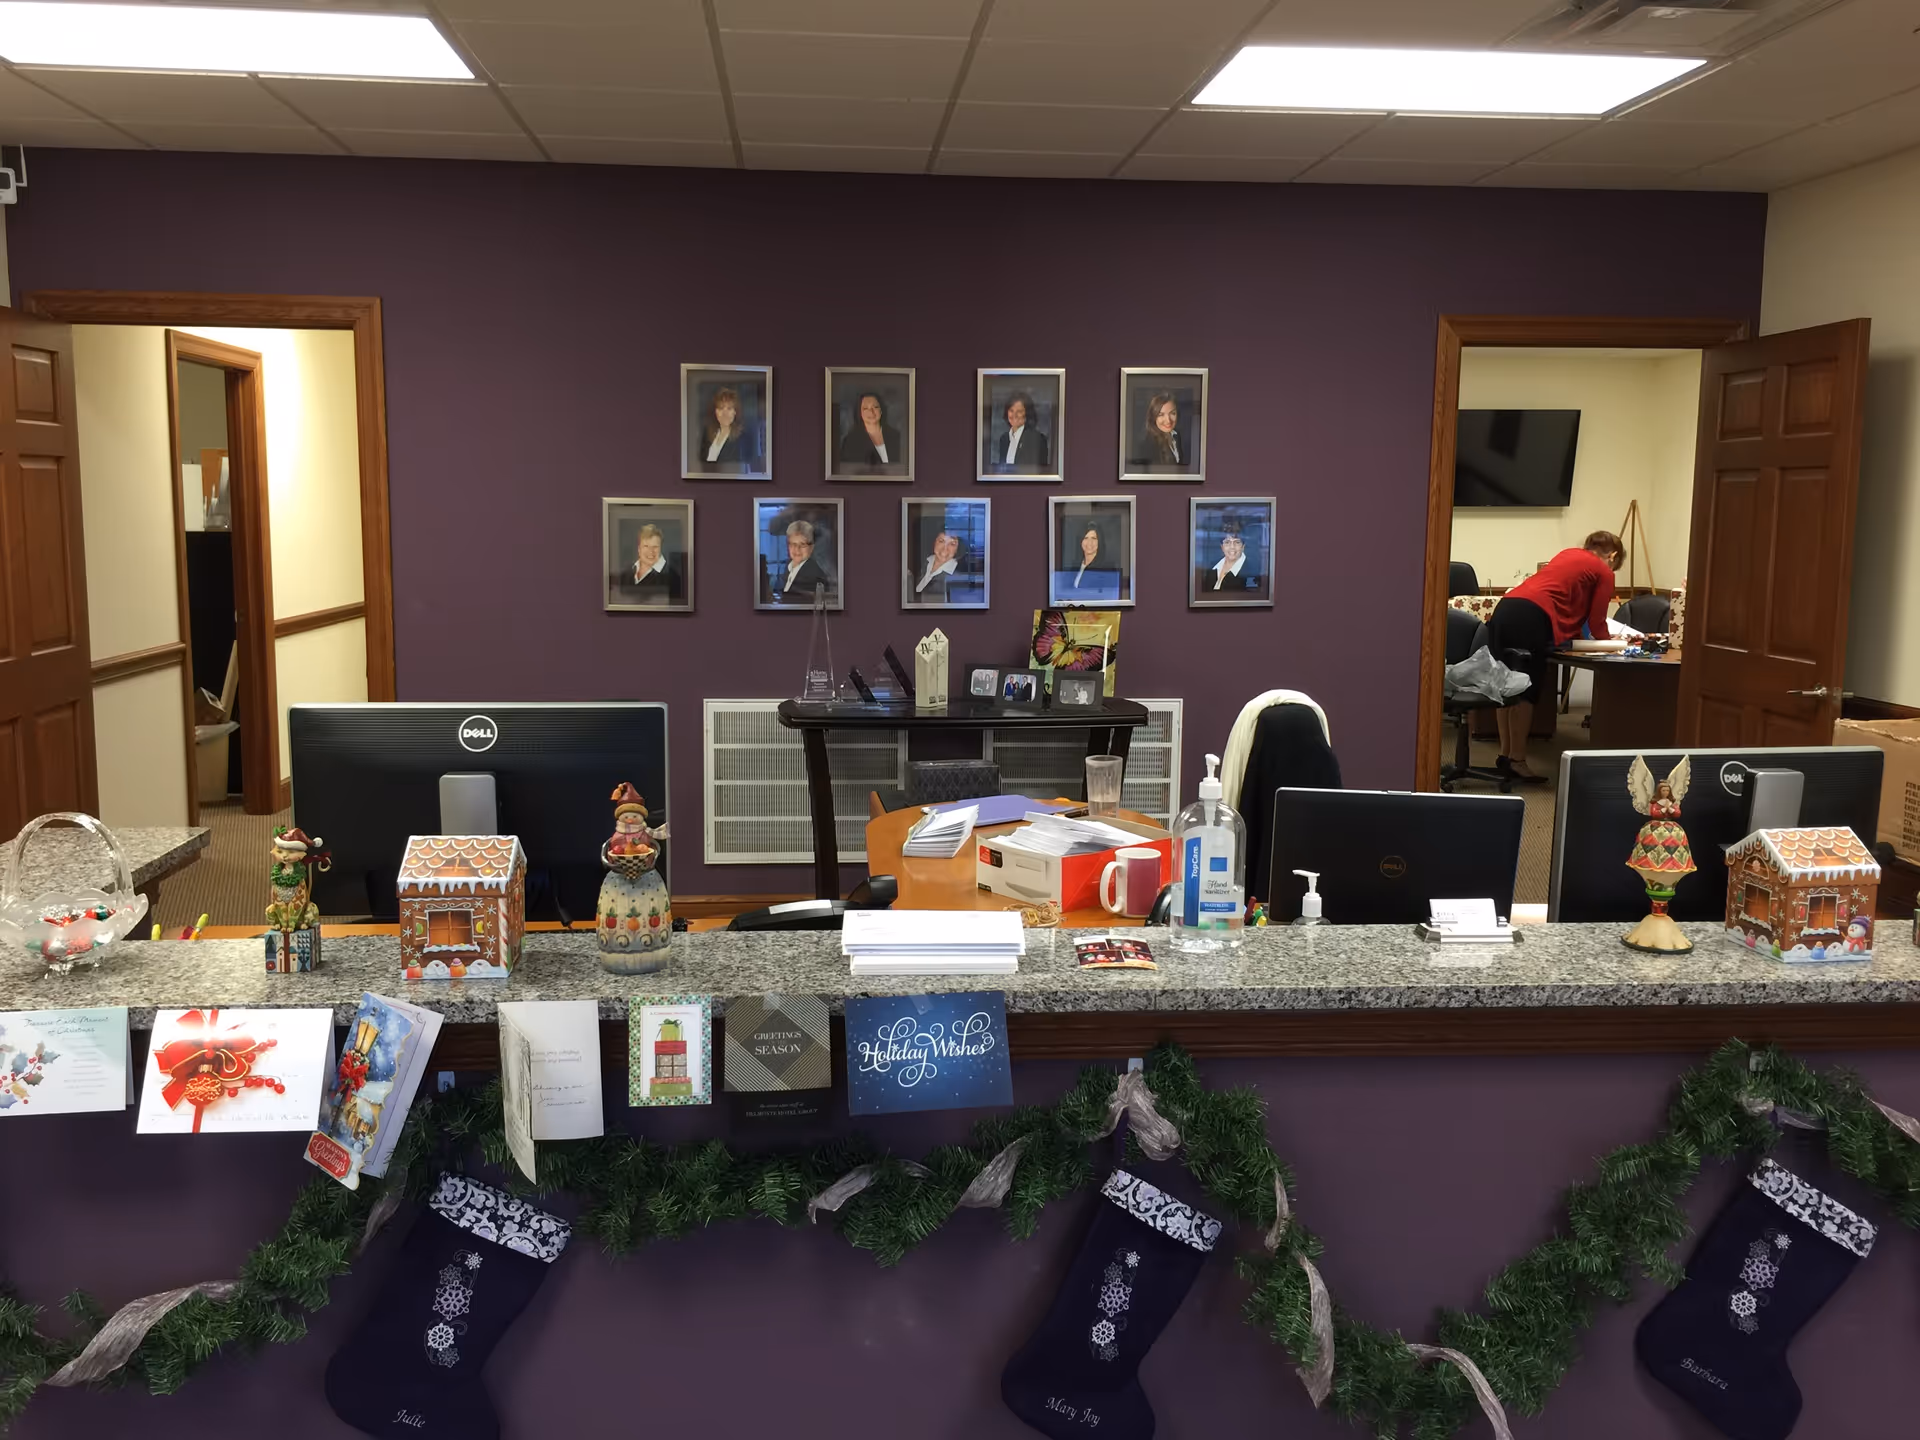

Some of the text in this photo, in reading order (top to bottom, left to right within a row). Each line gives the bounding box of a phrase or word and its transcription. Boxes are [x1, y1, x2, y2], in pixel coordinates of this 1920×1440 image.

[463, 728, 494, 738] DELL
[1723, 773, 1745, 783] DEL
[1191, 845, 1199, 878] TopCare
[1207, 880, 1228, 889] Hand
[754, 1031, 802, 1040] GREETINGS
[754, 1044, 801, 1055] SEASON
[858, 1012, 995, 1087] Holiday Wishes
[311, 1140, 347, 1174] Greetings
[1680, 1357, 1729, 1390] Barbara
[392, 1409, 426, 1428] Julie
[1045, 1396, 1101, 1428] Mary Joy
